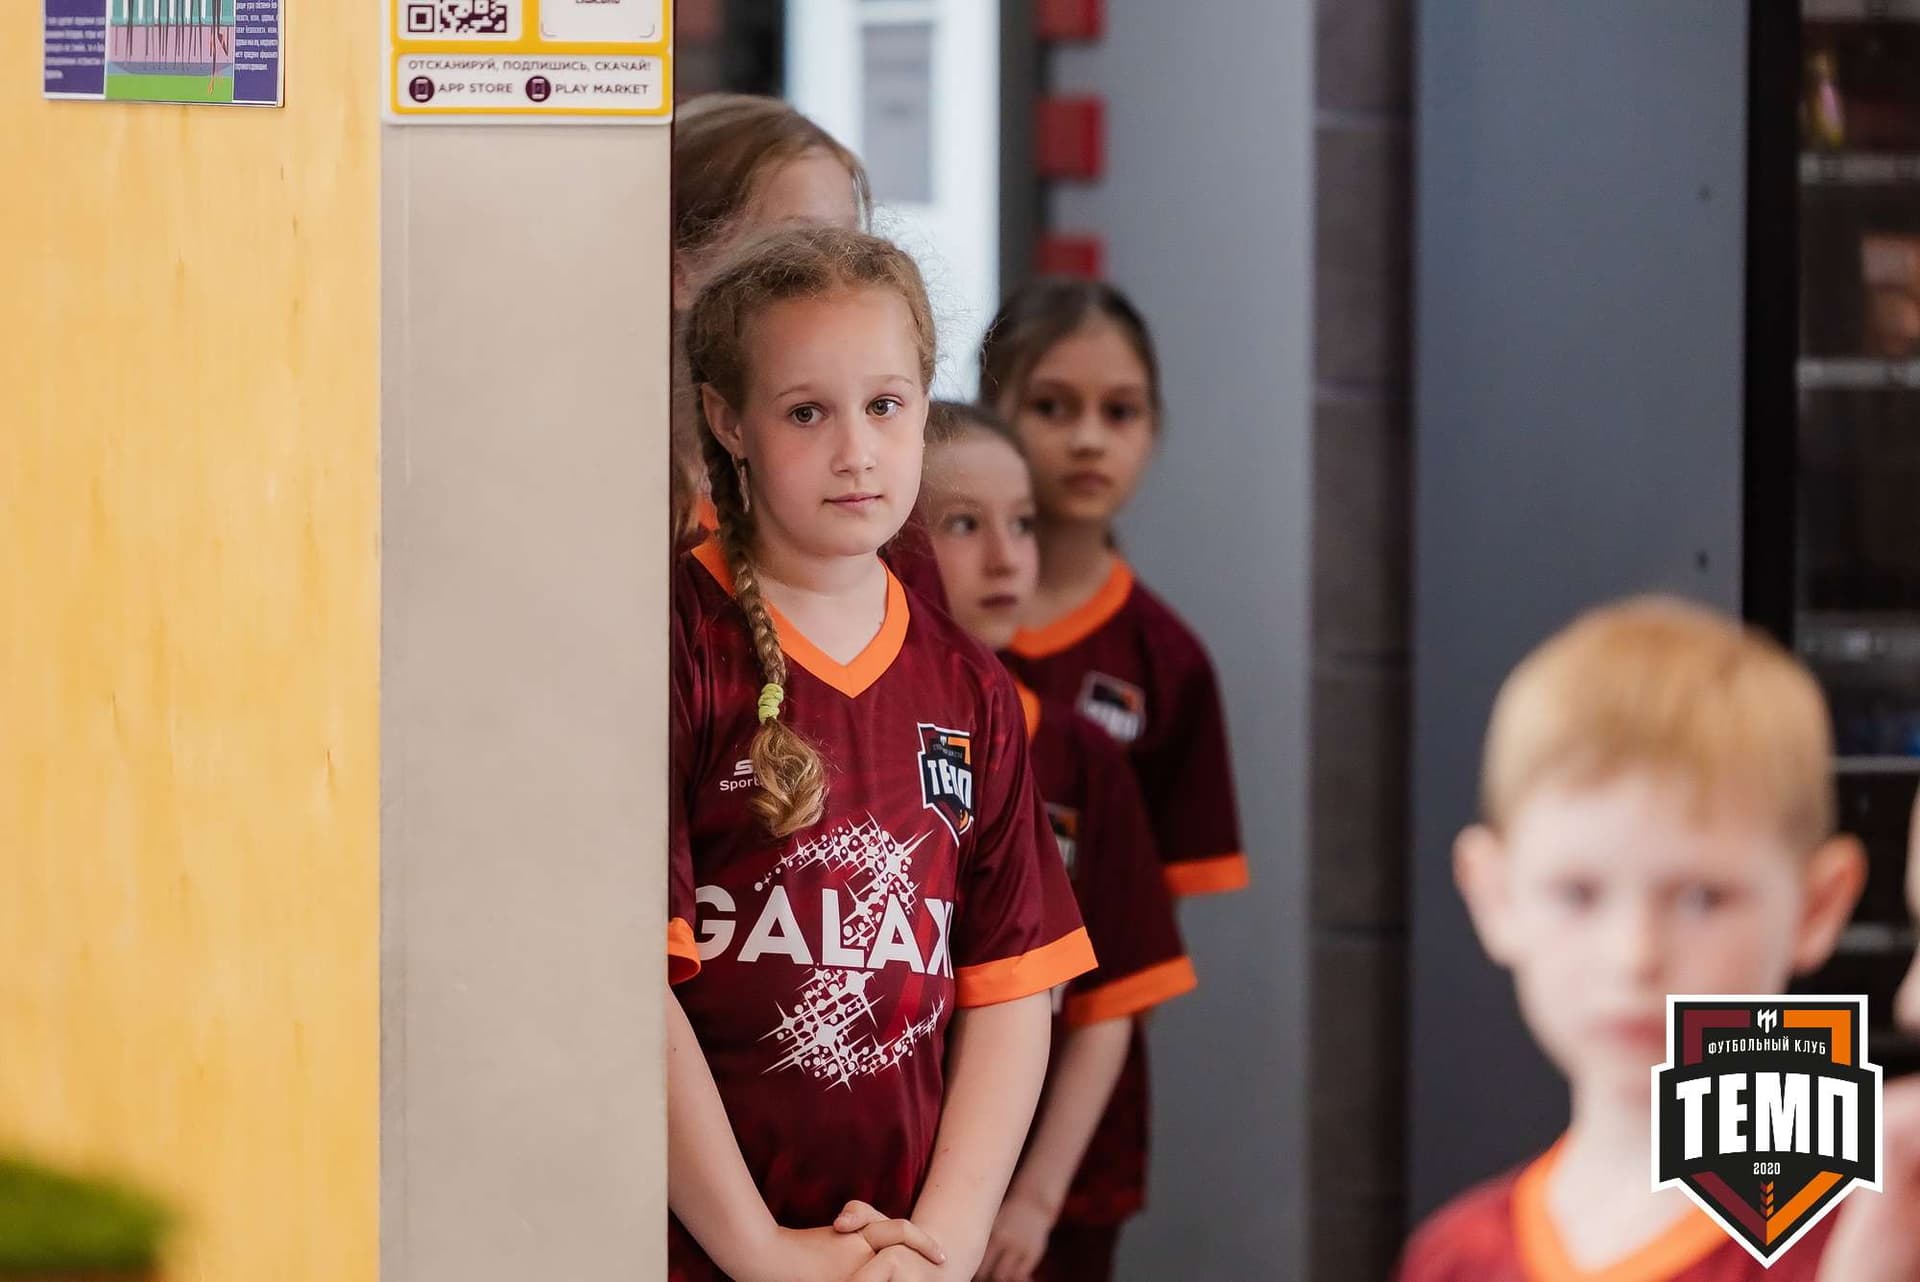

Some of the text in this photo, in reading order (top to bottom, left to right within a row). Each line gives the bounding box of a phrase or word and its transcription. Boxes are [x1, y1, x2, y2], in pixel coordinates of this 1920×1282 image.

[408, 58, 651, 72] ОТСКАНИРУЙ, ПОДПИШИСЬ, СКАЧАЙ!
[438, 83, 513, 93] APP STORE
[555, 84, 648, 94] PLAY MARKET
